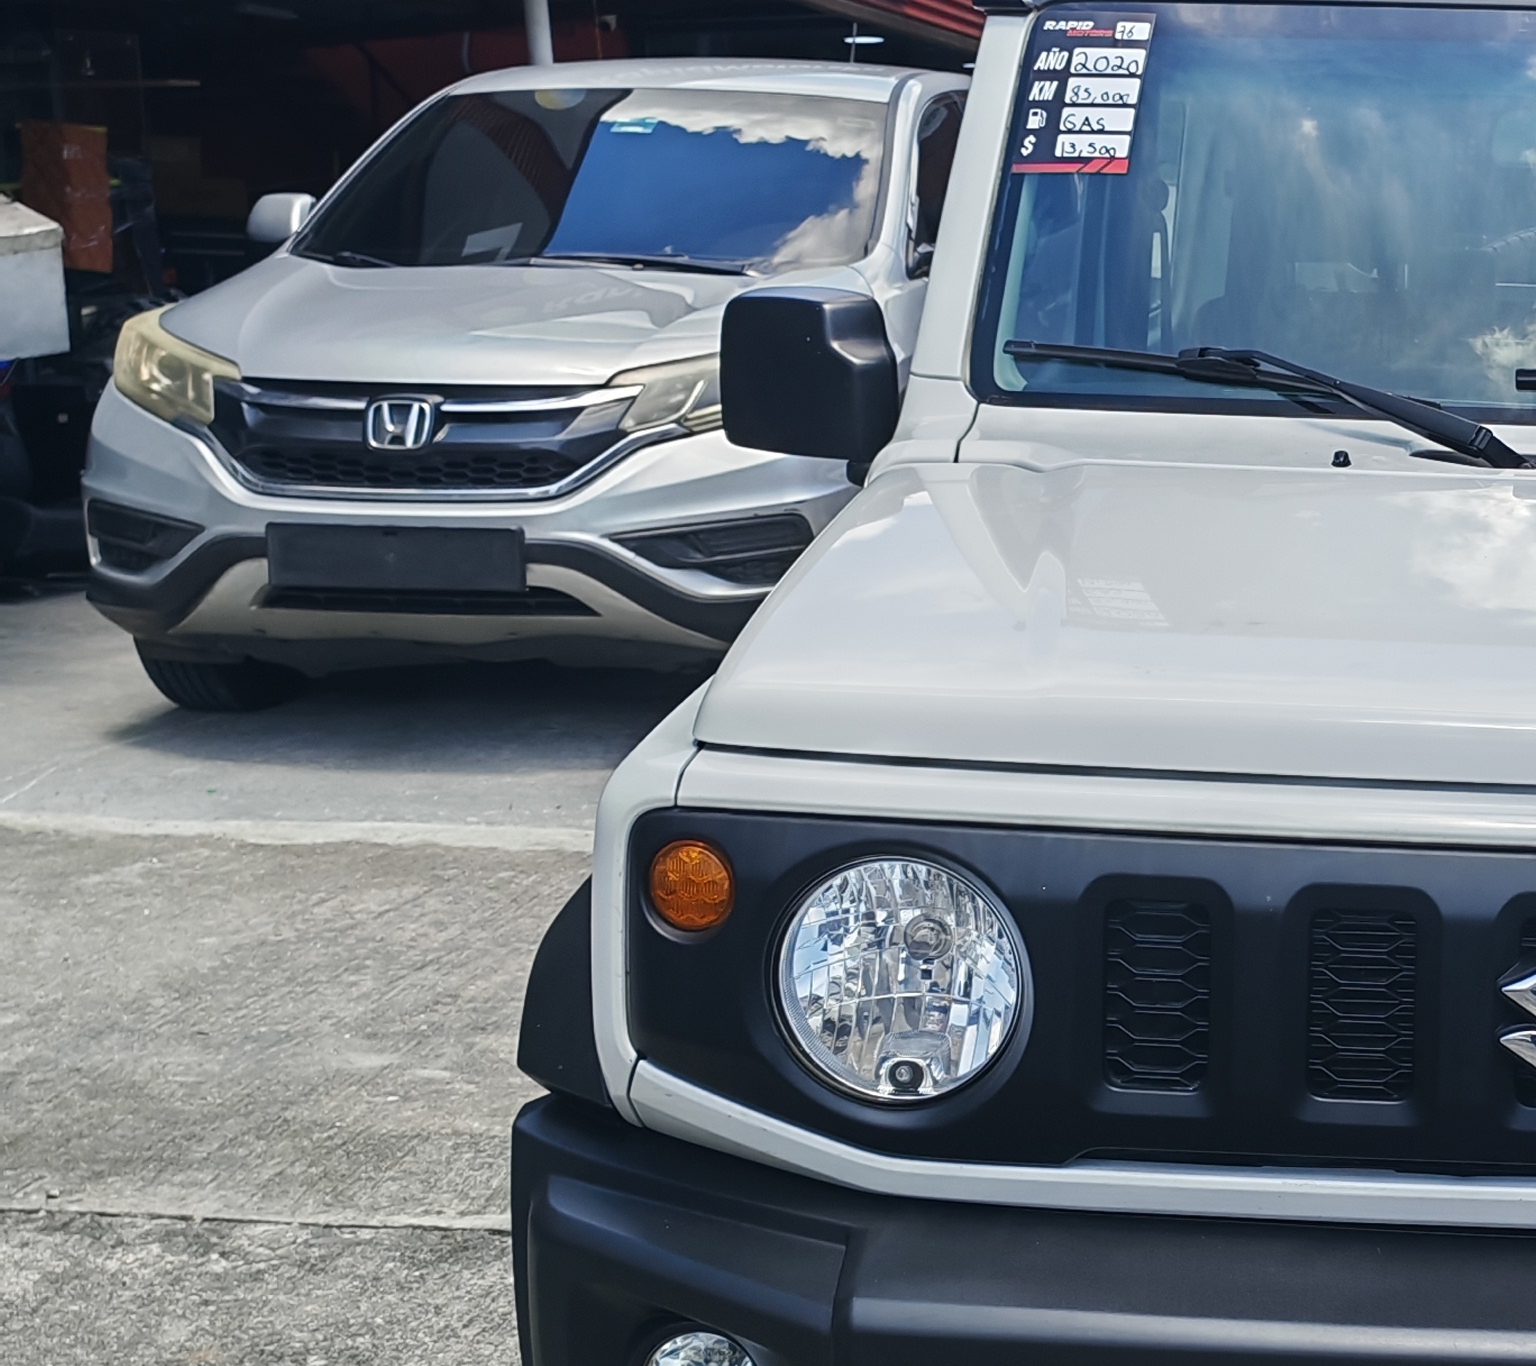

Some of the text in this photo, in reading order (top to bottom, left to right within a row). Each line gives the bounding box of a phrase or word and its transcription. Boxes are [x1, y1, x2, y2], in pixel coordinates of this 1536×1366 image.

[1043, 20, 1095, 30] RAPID
[1033, 47, 1140, 75] AÑO 2020
[1028, 80, 1059, 101] KM
[1063, 113, 1106, 132] GAS
[1020, 134, 1037, 157] $
